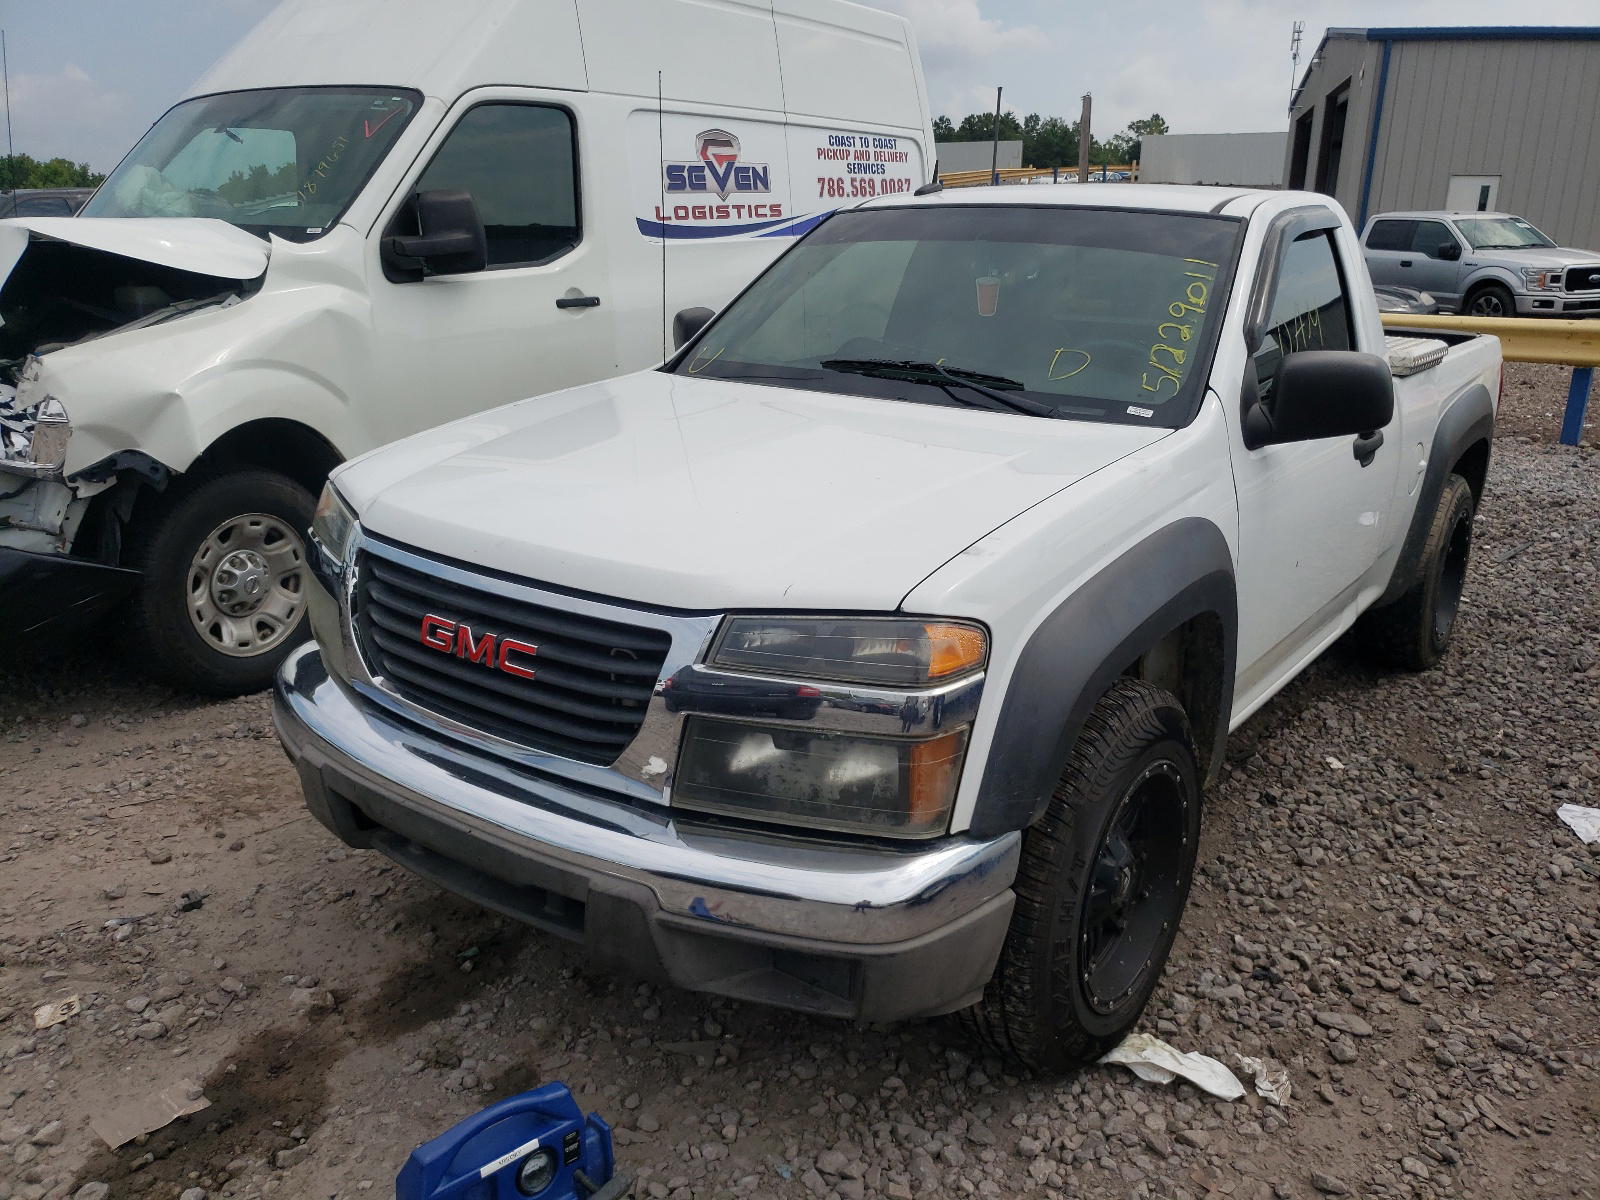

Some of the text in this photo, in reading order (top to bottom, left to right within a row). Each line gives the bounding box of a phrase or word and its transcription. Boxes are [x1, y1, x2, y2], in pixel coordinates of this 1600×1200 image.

[828, 134, 897, 150] COAST TO COAST
[817, 147, 909, 163] PICKUP AND DELIVERY
[666, 160, 770, 193] SEVEN
[846, 162, 886, 175] SERVICES
[817, 177, 911, 198] 786.569.0087
[655, 203, 782, 221] LOGISTICS
[420, 613, 538, 680] GMC
